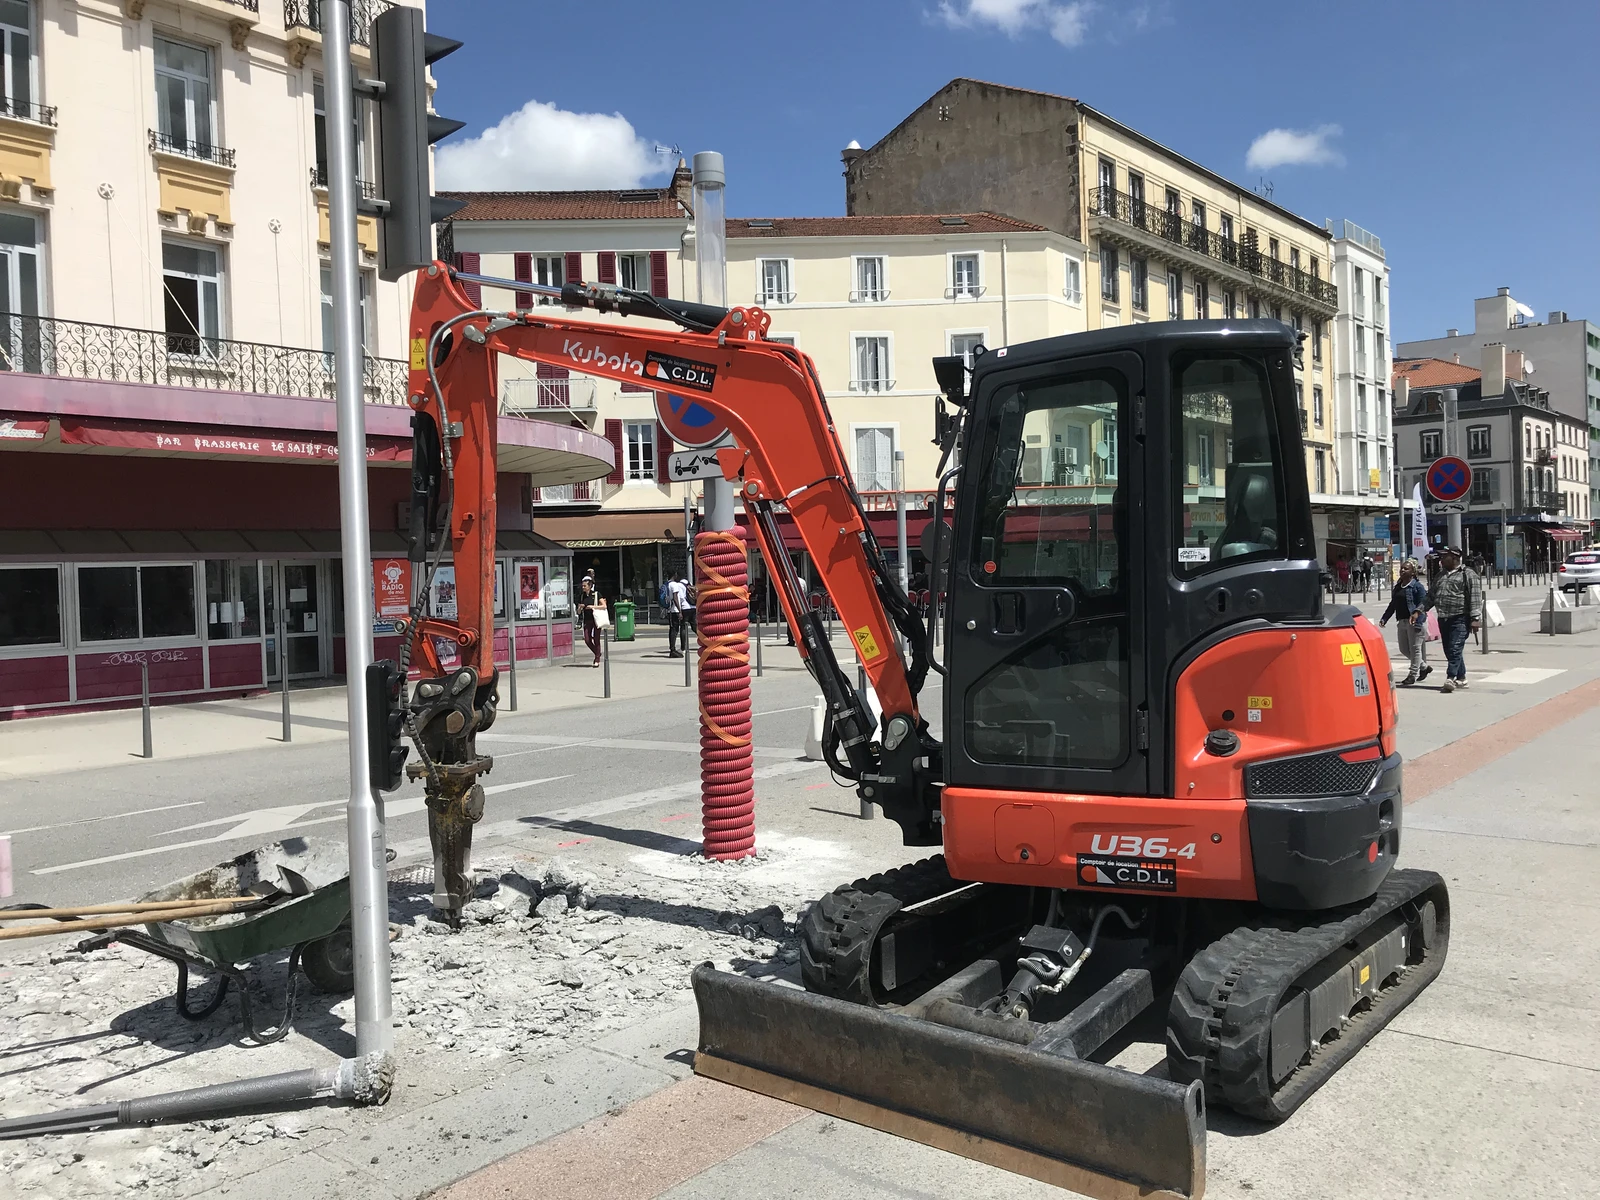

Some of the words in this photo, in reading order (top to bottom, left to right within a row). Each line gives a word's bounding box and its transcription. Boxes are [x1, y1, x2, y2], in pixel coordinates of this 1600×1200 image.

[563, 339, 644, 377] Kubota
[672, 366, 712, 386] C.D.L.
[381, 583, 404, 591] RADIO
[1354, 678, 1365, 694] 94
[1090, 834, 1197, 860] U36-4
[1080, 858, 1106, 866] Comptoir
[1116, 860, 1139, 868] location
[1116, 868, 1174, 885] C.D.L.
